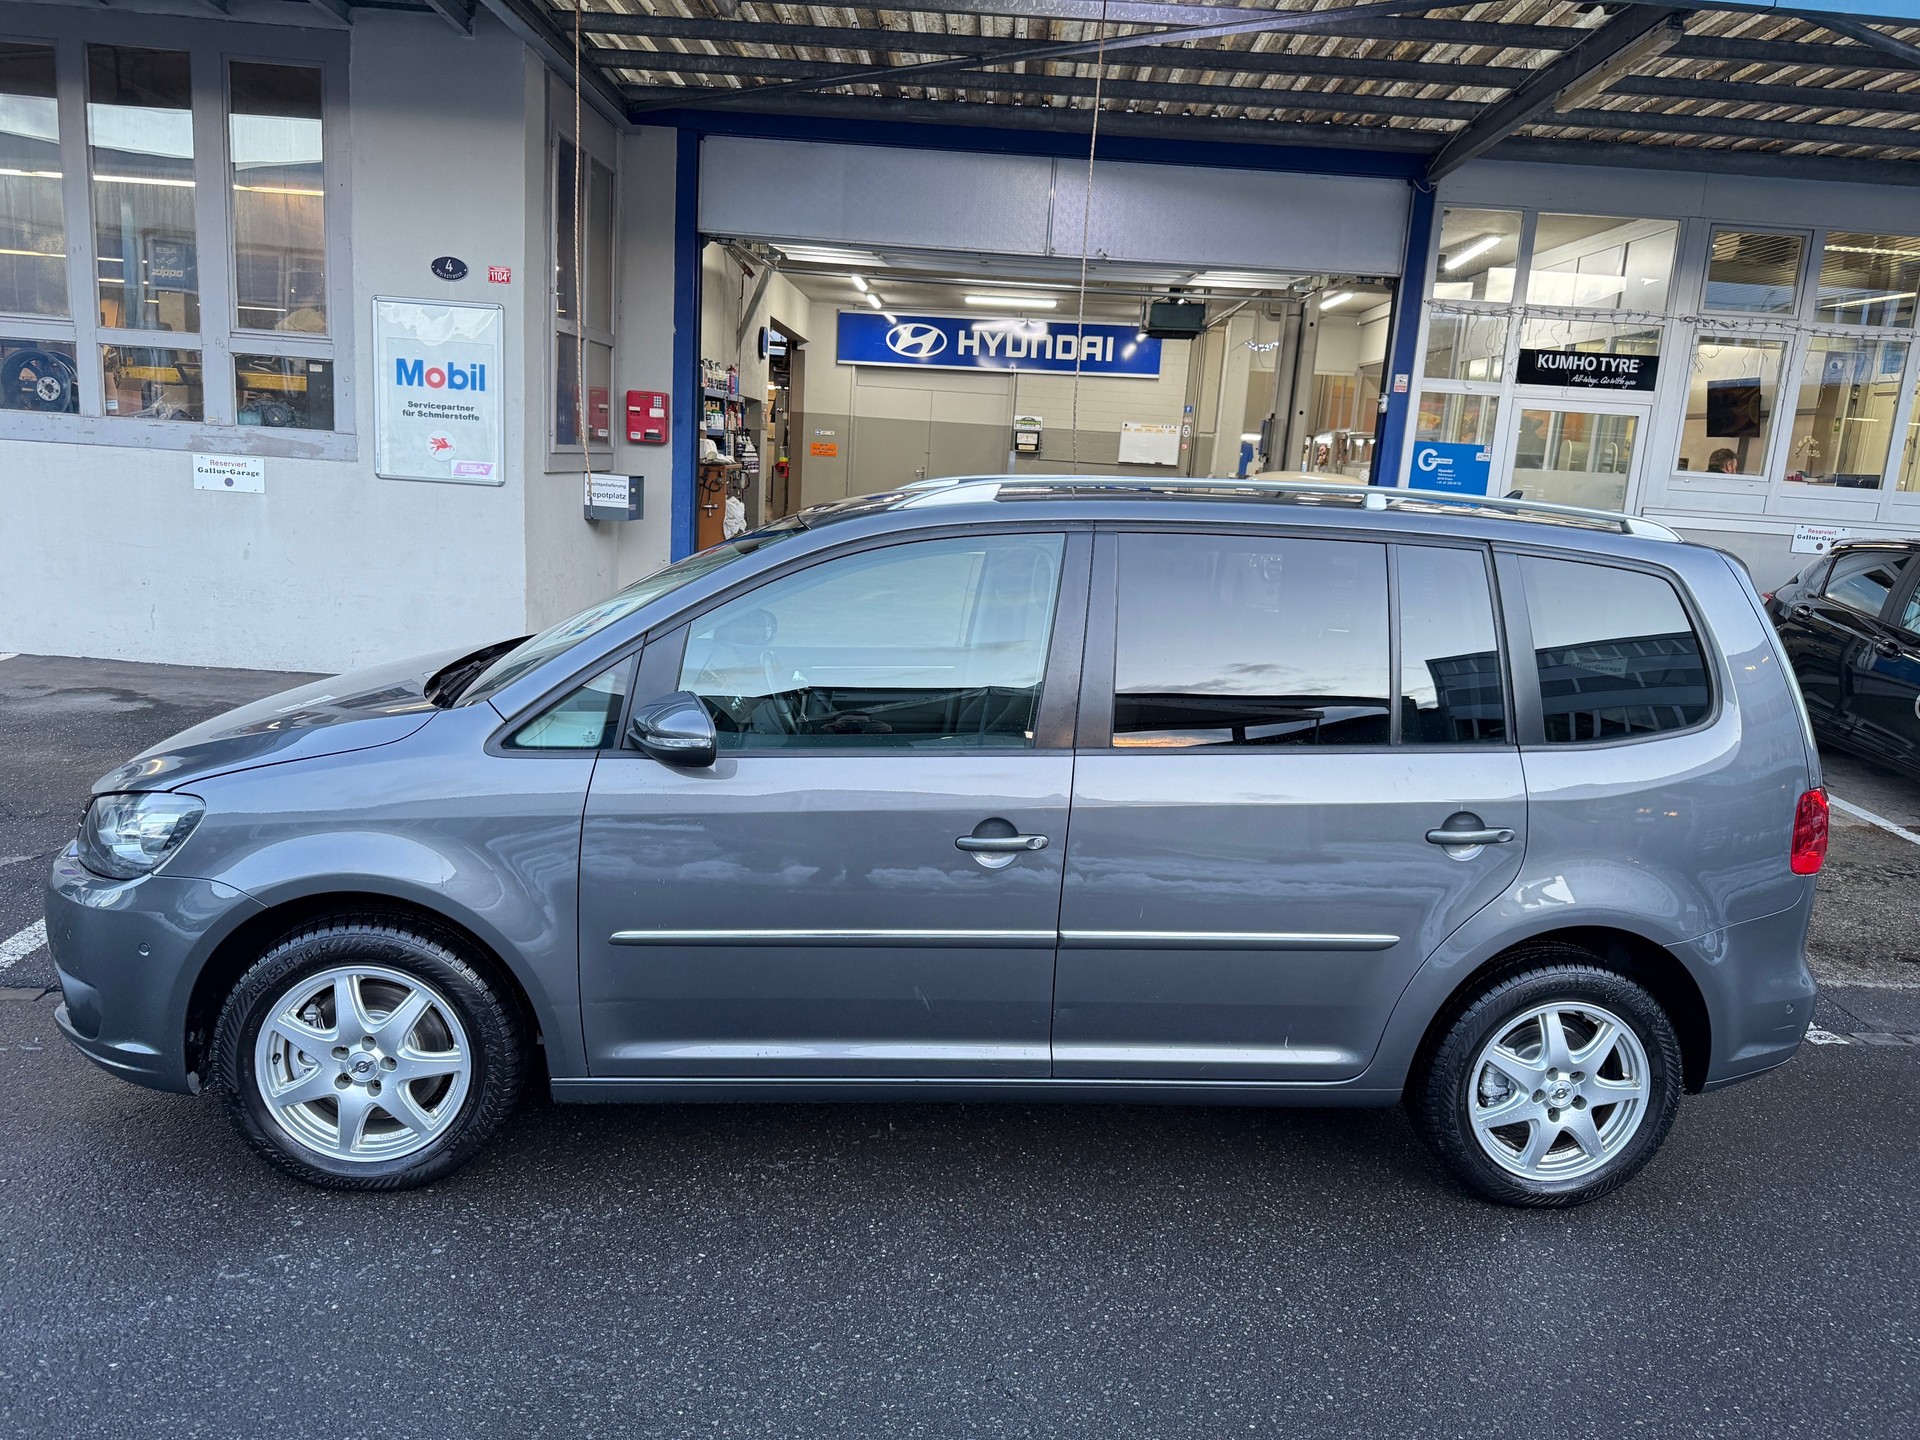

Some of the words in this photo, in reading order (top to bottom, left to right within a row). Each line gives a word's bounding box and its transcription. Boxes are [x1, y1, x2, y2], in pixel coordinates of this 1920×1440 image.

[445, 259, 454, 272] 4
[490, 271, 508, 282] 1104
[957, 329, 1115, 362] HYUNDAI
[1537, 353, 1597, 372] KUMHO
[1599, 357, 1640, 374] TYRE
[395, 357, 486, 392] Mobil
[407, 400, 475, 412] Servicepartner
[402, 409, 416, 417] für
[417, 410, 480, 421] Schmierstoffe
[209, 459, 247, 468] Reserviert
[197, 466, 260, 477] Gallus-Garage
[587, 481, 627, 489] chtanlieferung
[1807, 527, 1837, 535] Reserviert
[1796, 534, 1837, 542] Gallus-Gar
